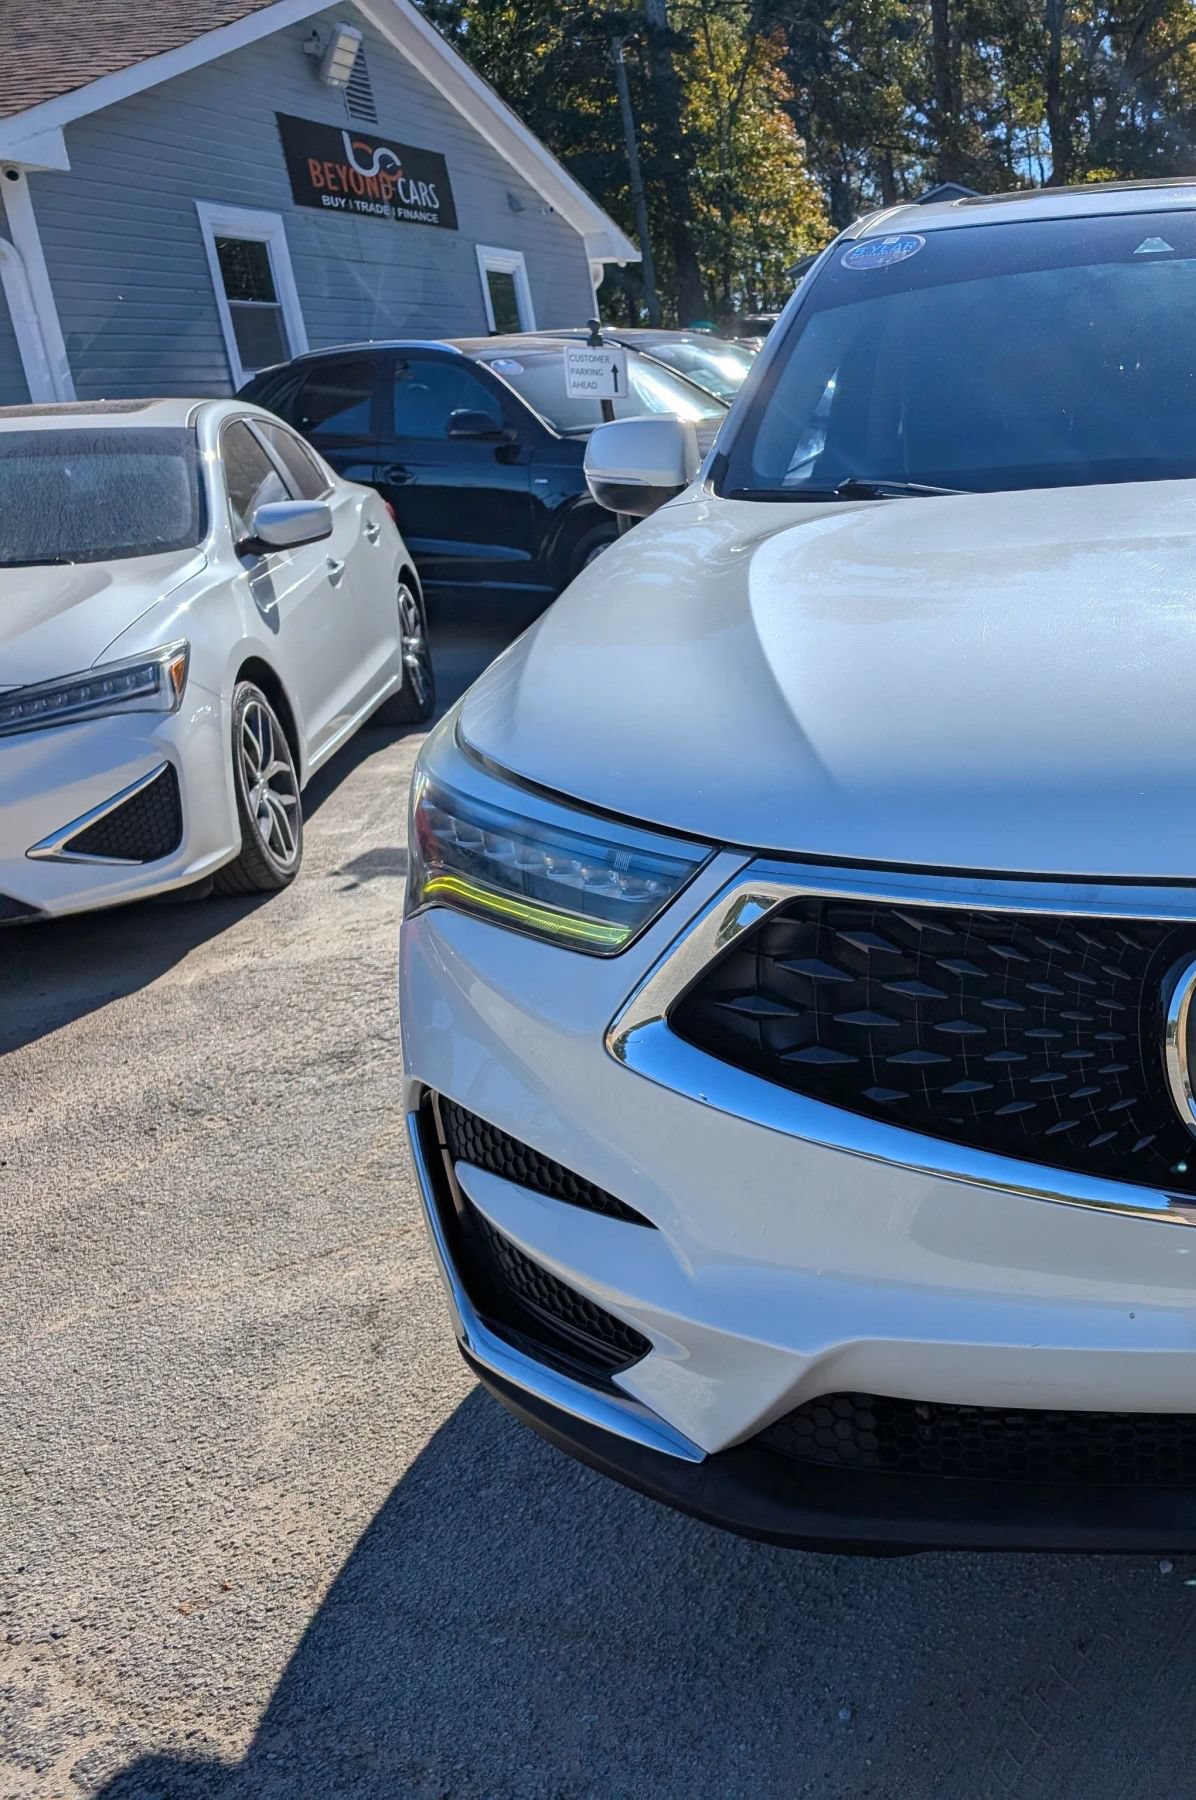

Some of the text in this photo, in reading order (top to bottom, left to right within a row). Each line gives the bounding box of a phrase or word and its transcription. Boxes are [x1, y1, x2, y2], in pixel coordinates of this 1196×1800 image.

[307, 158, 440, 209] BEYOND CARS
[321, 194, 440, 223] BUY TRADE FINANCE
[871, 241, 917, 254] YEAR
[569, 353, 610, 364] CUSTOMER
[570, 367, 604, 377] PARKING
[572, 381, 598, 389] AHEAD
